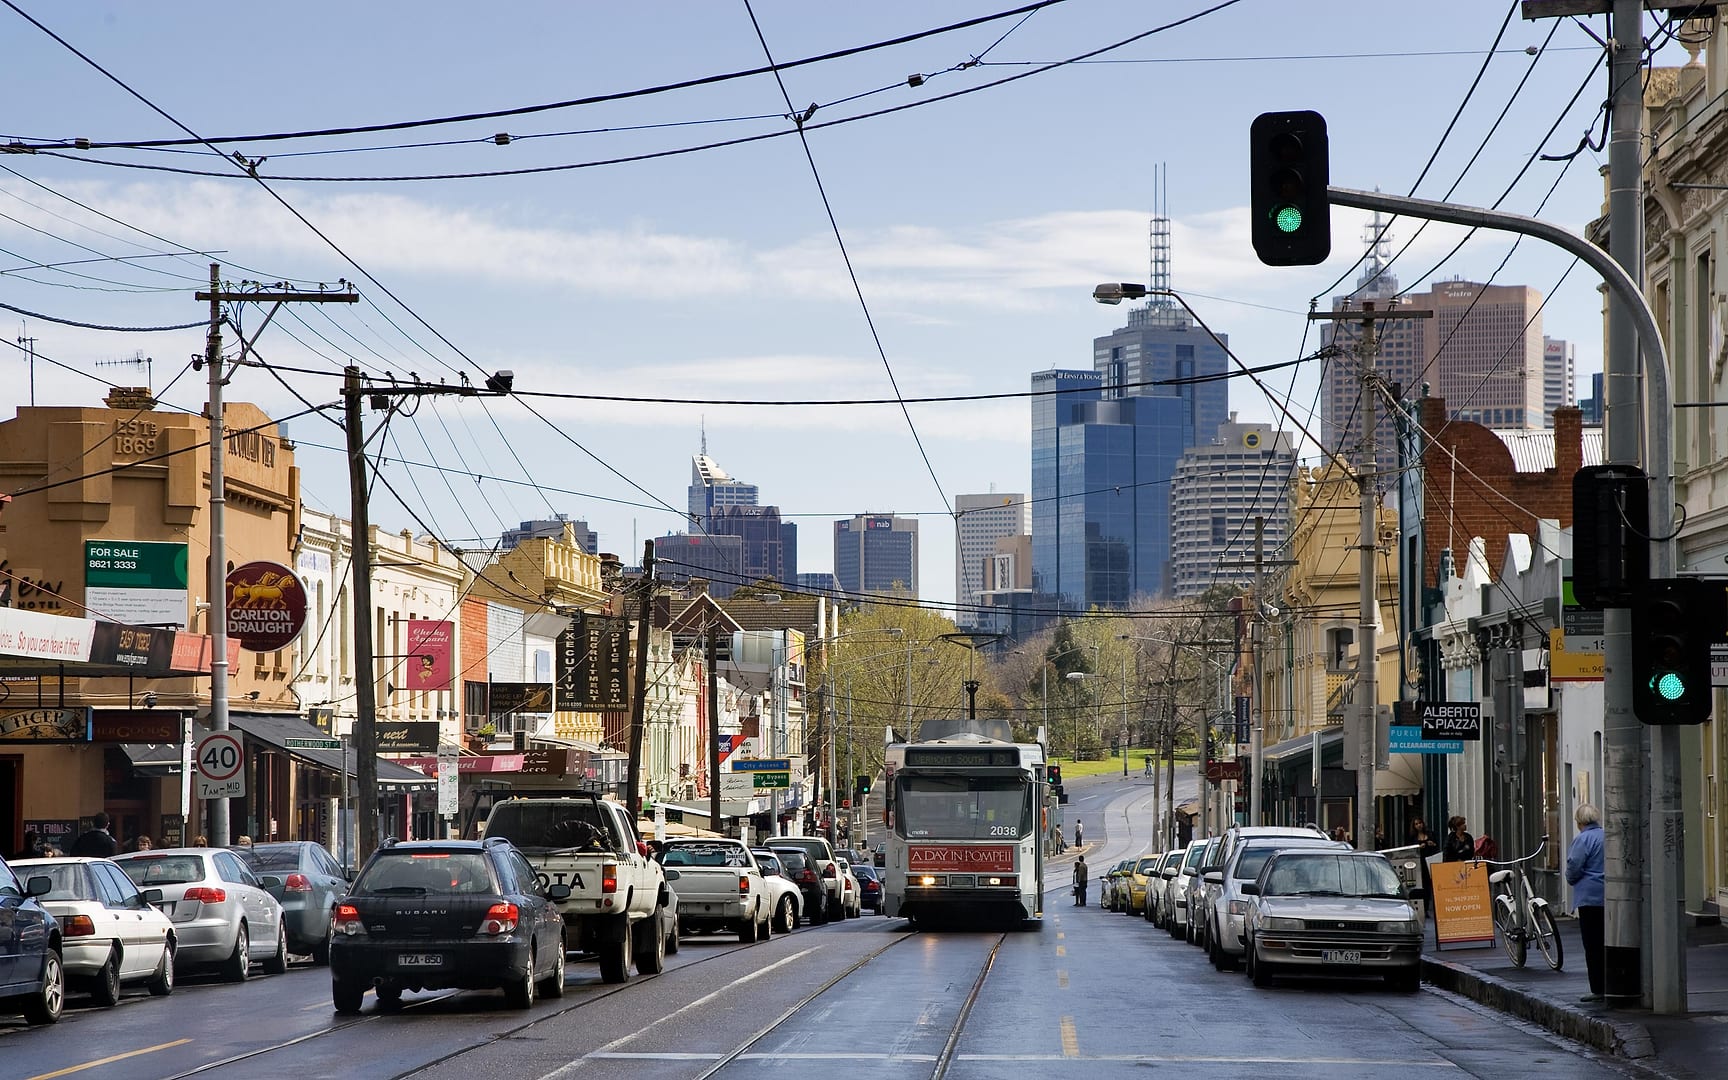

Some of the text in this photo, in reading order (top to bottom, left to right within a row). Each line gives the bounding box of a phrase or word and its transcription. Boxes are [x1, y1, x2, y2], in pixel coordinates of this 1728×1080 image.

[115, 436, 156, 456] 1869
[876, 520, 890, 528] nab
[90, 547, 139, 558] FOR SALE
[89, 560, 137, 570] 8621 3333
[17, 601, 62, 610] HOTEL
[230, 608, 291, 621] CARLTON
[227, 620, 295, 634] DRAUGHT
[17, 630, 26, 650] So
[26, 637, 38, 655] you
[564, 624, 575, 699] EXECUTIVE
[588, 629, 600, 701] RECRUITMENT
[1423, 706, 1479, 717] ALBERTO
[1435, 718, 1479, 729] PIAZZA
[286, 738, 333, 748] ROTHERWOOD ST
[202, 746, 237, 769] 40
[753, 773, 764, 781] City
[226, 782, 240, 791] MID
[990, 825, 1017, 836] 2038
[911, 850, 1012, 862] A DAY IN POMPEII
[1445, 903, 1481, 912] NOW OPEN
[1322, 951, 1360, 961] WIT 629
